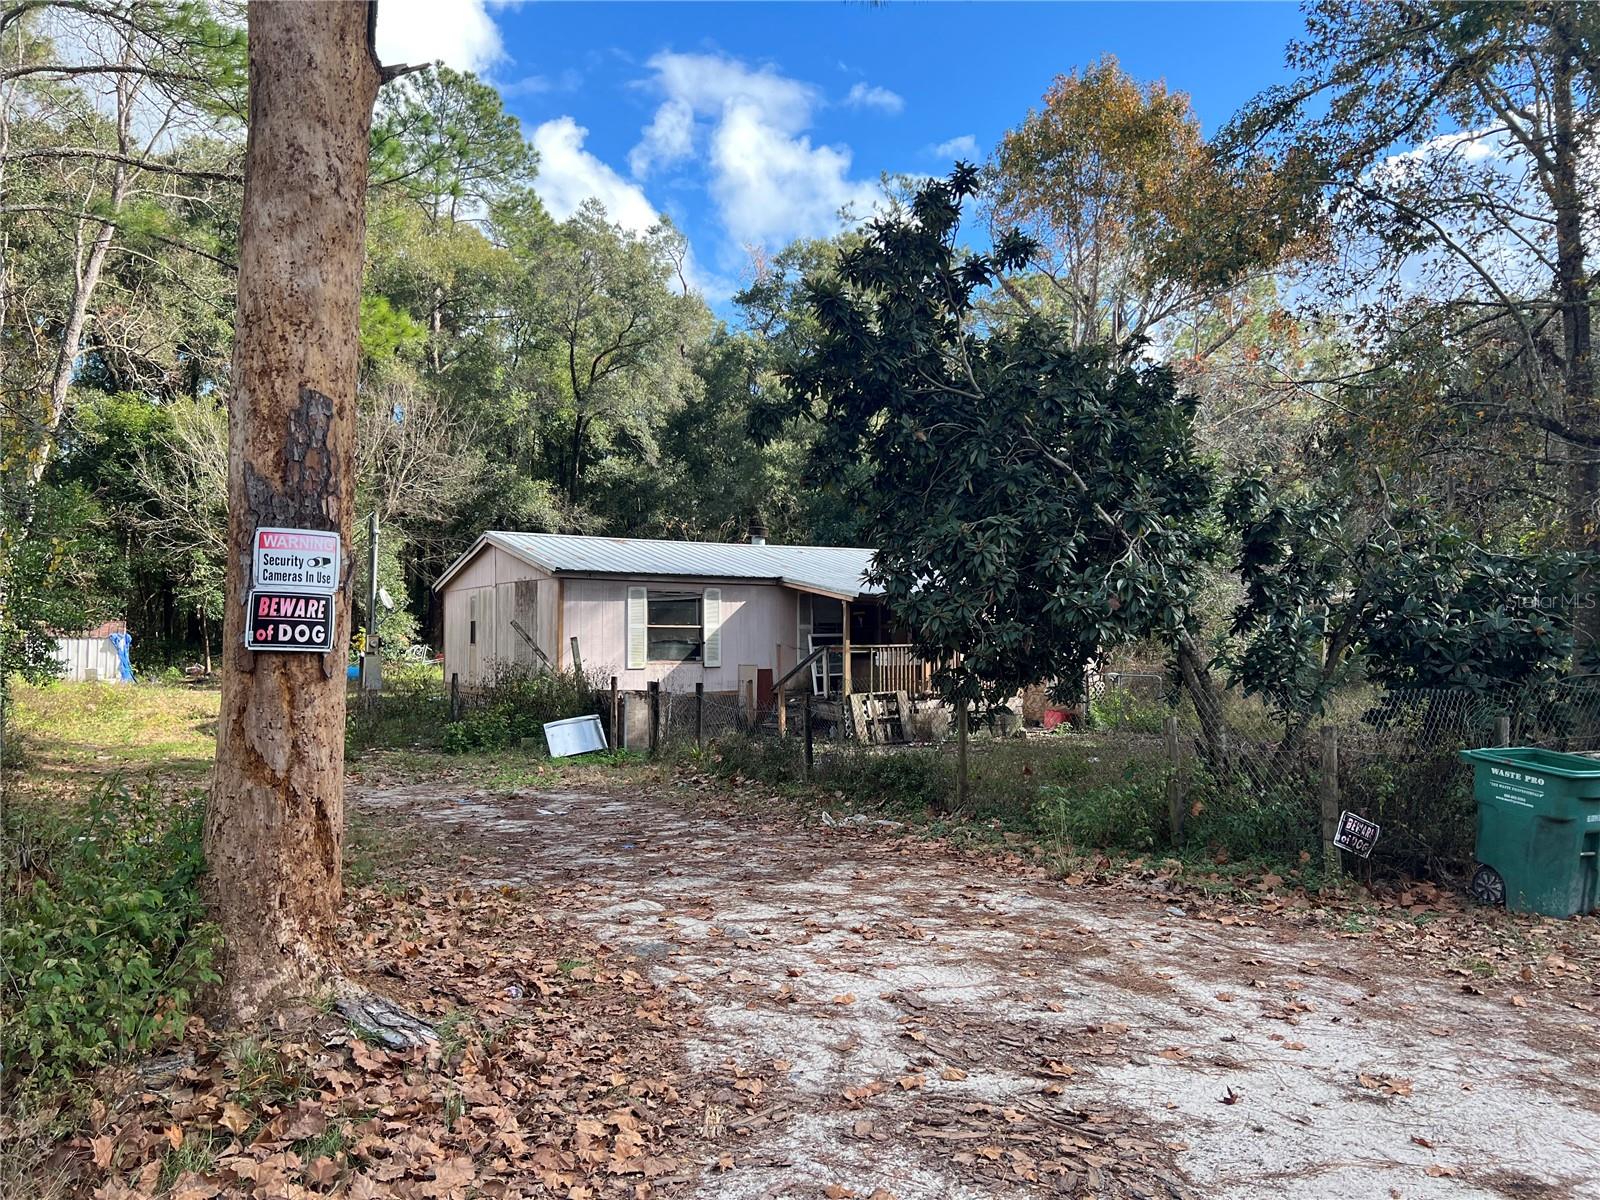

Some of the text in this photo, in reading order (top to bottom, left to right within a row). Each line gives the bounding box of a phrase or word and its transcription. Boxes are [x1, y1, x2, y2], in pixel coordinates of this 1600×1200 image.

[263, 534, 335, 550] WARNING
[263, 553, 304, 569] Security
[262, 568, 331, 584] Cameras In Use
[258, 596, 326, 619] BEWARE
[256, 624, 325, 643] of DOG
[1490, 767, 1545, 786] WASTE PRO
